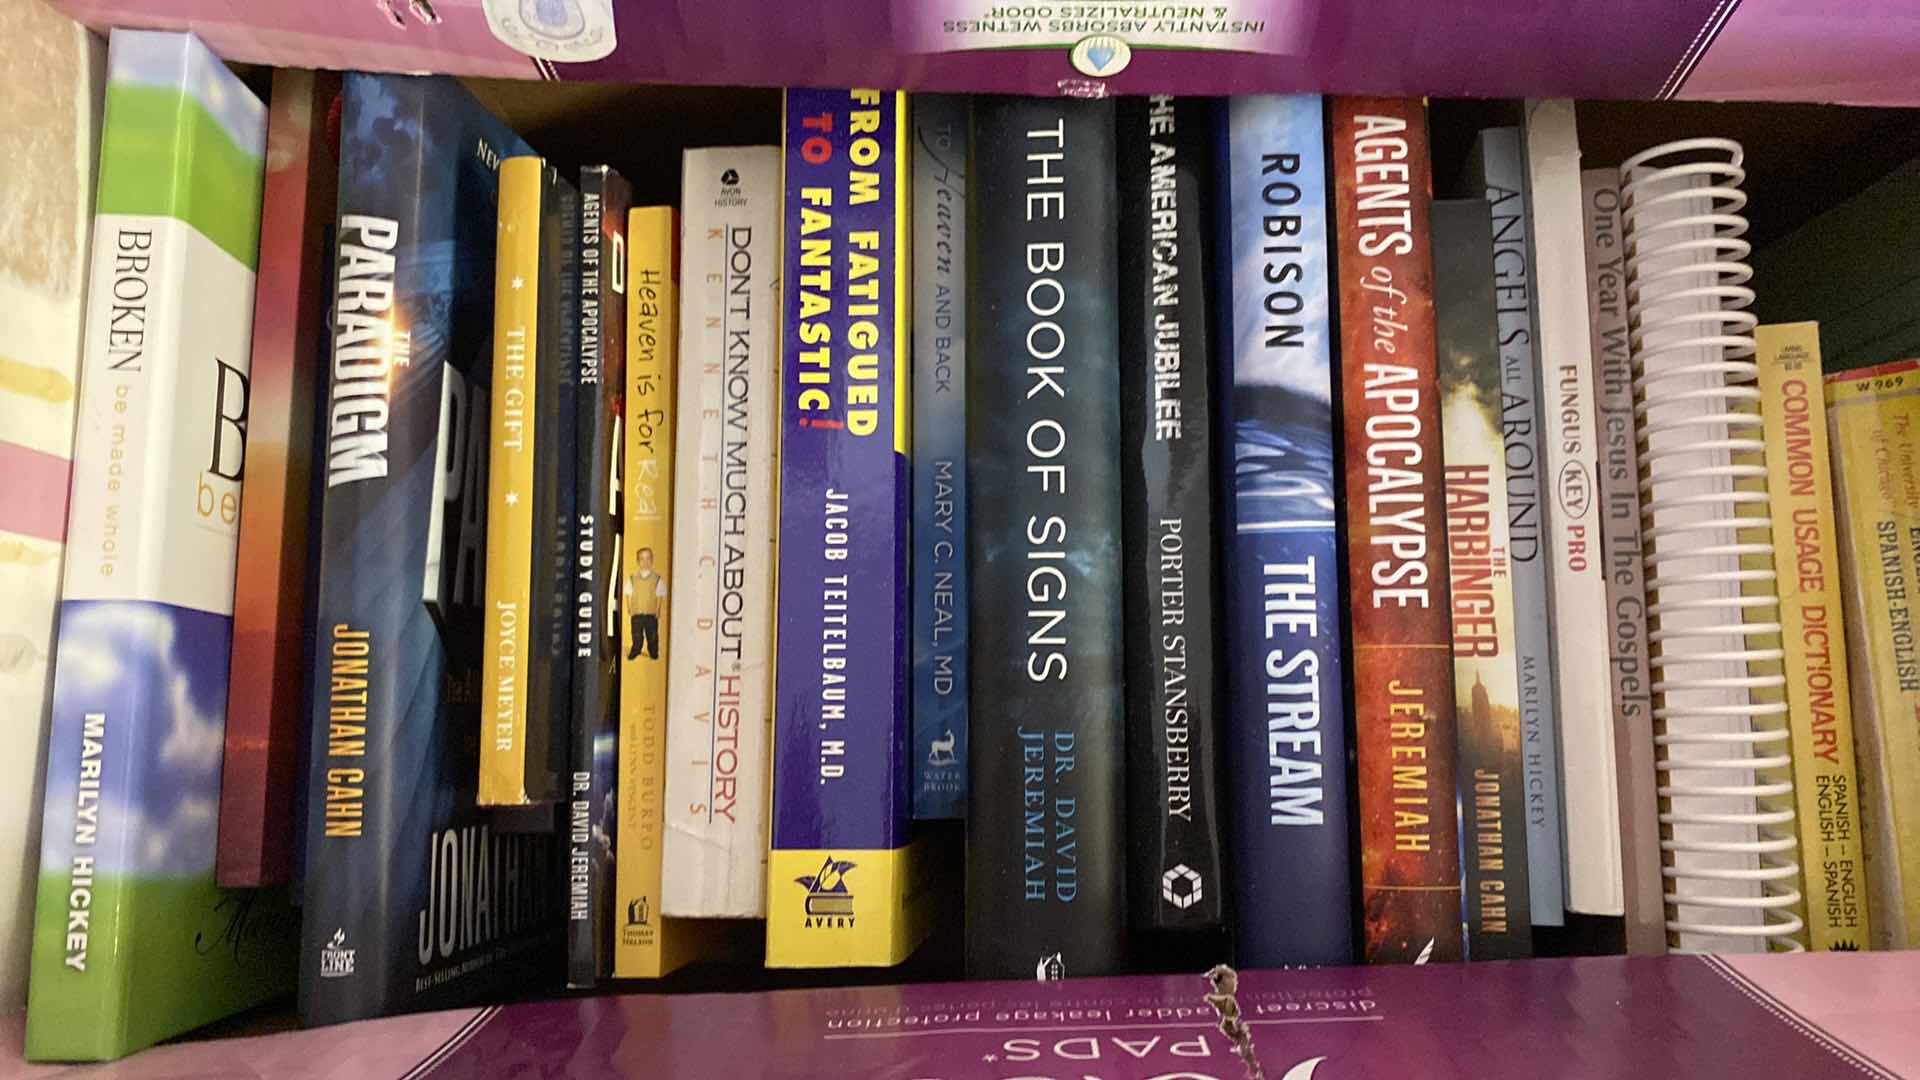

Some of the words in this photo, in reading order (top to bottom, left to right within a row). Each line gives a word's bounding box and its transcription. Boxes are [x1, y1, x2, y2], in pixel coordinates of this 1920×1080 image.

[942, 20, 1041, 33] WETNESS
[1049, 20, 1147, 33] ABSORBS
[1059, 6, 1205, 19] NEUTRALIZES
[1154, 20, 1265, 33] INSTANTLY
[1213, 6, 1227, 18] &
[801, 111, 832, 166] TO
[849, 88, 881, 205] FROM
[939, 126, 950, 147] TO
[1150, 95, 1176, 137] HE
[714, 198, 748, 207] HISTORY
[720, 187, 741, 197] AVON
[1026, 118, 1065, 222] THE
[1353, 114, 1414, 257] AGENTS
[583, 192, 600, 245] AGENTS
[1150, 142, 1179, 308] AMERICAN
[1261, 152, 1305, 349] ROBISON
[1593, 188, 1619, 249] One
[581, 272, 600, 296] THE
[582, 250, 600, 271] OF
[1360, 264, 1408, 306] of
[1597, 256, 1622, 317] Year
[108, 229, 152, 373] BROKEN
[638, 270, 661, 362] Heaven
[798, 187, 845, 430] FANTASTIC!
[847, 231, 879, 437] FATIGUED
[936, 286, 951, 330] AND
[1026, 242, 1066, 400] BOOK
[1372, 304, 1409, 356] the
[328, 214, 399, 488] PARADIGM
[392, 329, 411, 368] THE
[506, 326, 525, 378] THE
[580, 300, 600, 385] APOCALYPSE
[936, 337, 951, 393] BACK
[1154, 313, 1182, 441] JUBILEE
[1505, 354, 1521, 384] ALL
[1600, 322, 1632, 394] With
[114, 384, 129, 413] be
[637, 373, 661, 396] is
[727, 330, 751, 432] KNOW
[1559, 364, 1582, 455] FUNGUS
[1856, 382, 1870, 393] W
[503, 391, 524, 452] GIFT
[636, 407, 664, 454] for
[1026, 418, 1067, 494] OF
[1600, 402, 1632, 482] Jesus
[1781, 379, 1815, 497] COMMON
[108, 424, 126, 491] made
[633, 458, 661, 520] Real
[724, 440, 748, 535] MUCH
[1363, 362, 1430, 610] APOCALYPSE
[1500, 391, 1539, 563] AROUND
[1564, 468, 1585, 511] KEY
[196, 471, 237, 525] be
[825, 488, 849, 561] JACOB
[934, 460, 953, 532] MARY
[1611, 492, 1636, 520] In
[100, 504, 121, 577] whole
[579, 514, 594, 581] STUDY
[933, 541, 953, 564] C.
[1159, 517, 1185, 627] PORTER
[1444, 463, 1500, 659] HARBINGER
[1490, 545, 1507, 577] THE
[1567, 524, 1587, 573] PRO
[1612, 532, 1642, 586] The
[1792, 508, 1824, 593] USAGE
[577, 593, 593, 658] GUIDE
[932, 571, 953, 647] NEAL,
[1026, 515, 1068, 683] SIGNS
[1263, 556, 1319, 640] THE
[1876, 520, 1920, 693] SPANISH-ENGLISH
[496, 601, 517, 674] JOYCE
[817, 575, 848, 731] TEITELBAUM,
[1609, 596, 1650, 718] Gospels
[328, 623, 370, 757] JONATHAN
[933, 655, 953, 696] MD
[1522, 655, 1541, 744] MARILYN
[1801, 604, 1840, 766] DICTIONARY
[495, 678, 516, 752] MEYER
[642, 704, 657, 766] TODD
[715, 675, 740, 824] HISTORY
[1162, 634, 1192, 823] STANSBERRY
[1265, 649, 1324, 826] STREAM
[75, 712, 105, 846] MARILYN
[572, 771, 590, 797] DR.
[820, 739, 845, 785] M.D.
[922, 783, 961, 793] BROOK
[1054, 729, 1076, 786] DR.
[1385, 678, 1431, 853] JEREMIAH
[1527, 752, 1546, 829] HICKEY
[325, 767, 364, 838] CAHN
[572, 801, 590, 844] DAVID
[640, 777, 657, 850] BURPO
[1017, 726, 1047, 902] JEREMIAH
[1472, 767, 1506, 870] JONATHAN
[1816, 774, 1836, 843] ENGLISH
[1832, 775, 1851, 842] SPANISH
[571, 847, 590, 921] JEREMIAH
[1055, 798, 1078, 903] DAVID
[65, 855, 94, 972] HICKEY
[418, 825, 545, 966] JONATH
[804, 917, 856, 928] AVERY
[1478, 878, 1508, 934] CAHN
[1823, 860, 1842, 929] SPANISH
[1839, 859, 1858, 928] ENGLISH
[320, 960, 355, 973] LINE
[321, 949, 355, 961] FRONT
[827, 1010, 980, 1031] protection
[996, 1009, 1112, 1023] leakage
[1125, 1007, 1212, 1020] adder
[1256, 999, 1377, 1016] discreet
